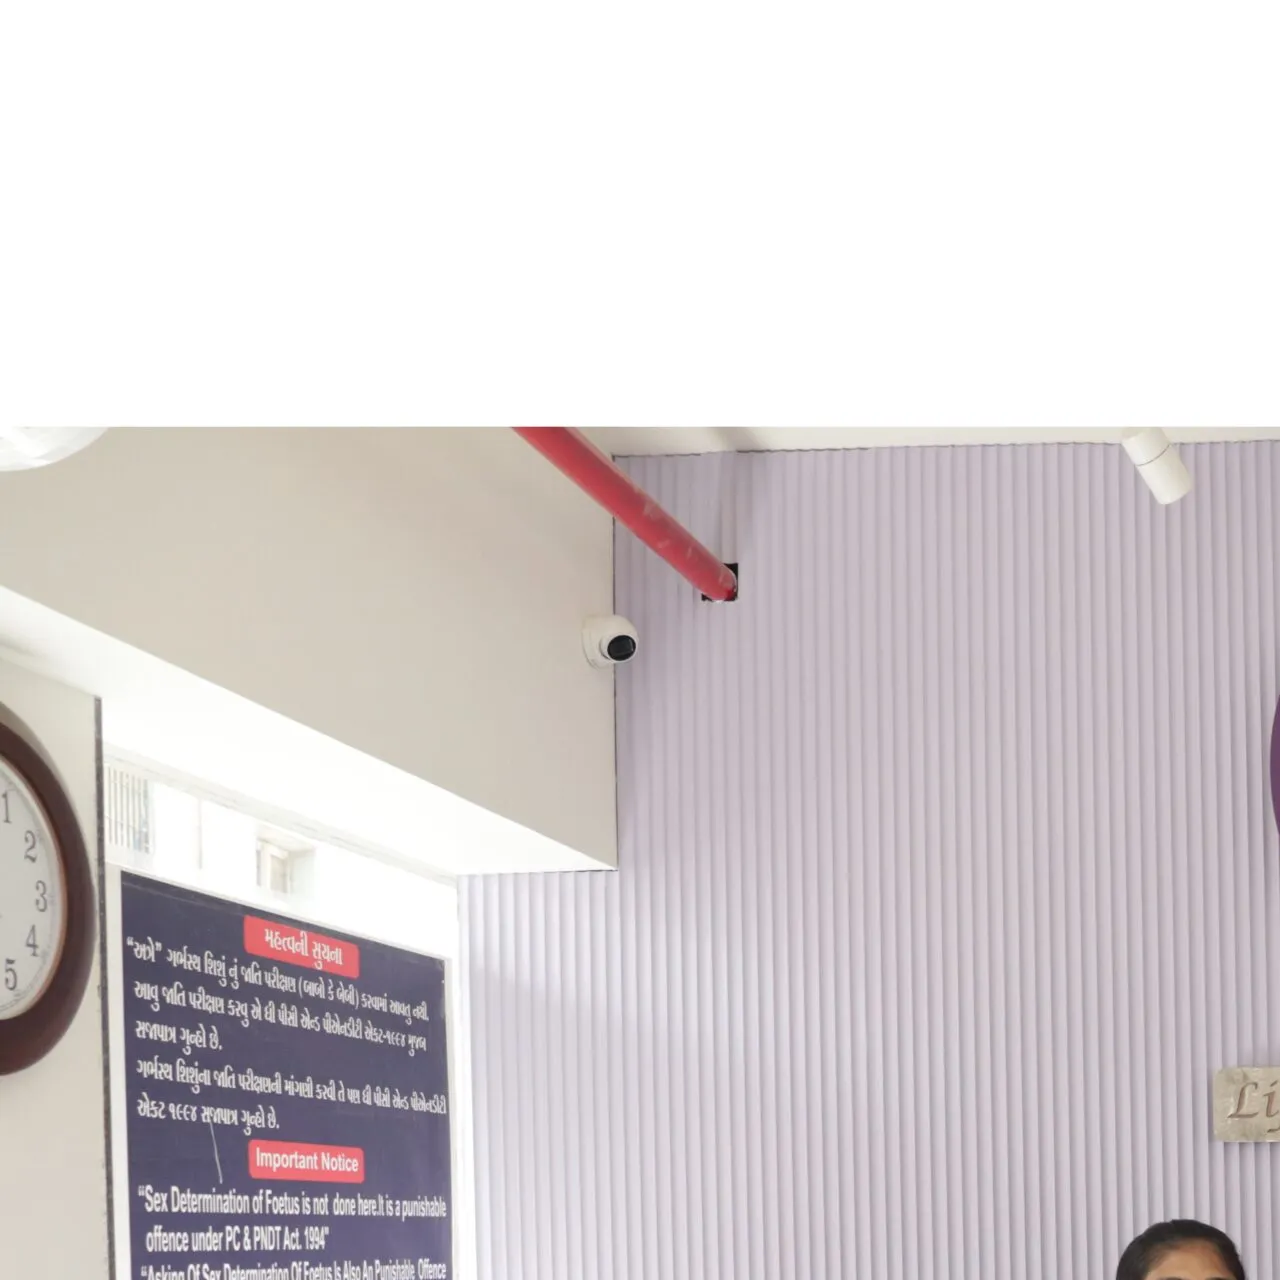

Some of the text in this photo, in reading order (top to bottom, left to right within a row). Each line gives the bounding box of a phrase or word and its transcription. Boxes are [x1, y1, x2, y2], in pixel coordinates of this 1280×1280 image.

[2, 790, 12, 824] 1
[24, 829, 37, 863] 2
[35, 880, 47, 912] 3
[25, 924, 39, 957] 4
[5, 958, 18, 991] 5
[166, 945, 201, 972] ગર્ભસ્થ
[241, 961, 262, 985] જાતિ
[264, 966, 297, 993] પરીક્ષણ
[327, 979, 335, 1001] કે
[361, 992, 388, 1013] કરવામાં
[162, 981, 187, 1007] જાતિ
[188, 986, 225, 1014] પરીક્ષણ
[251, 996, 262, 1021] એ
[278, 1003, 298, 1028] પીસી
[407, 1034, 427, 1057] મુજબ
[136, 1055, 173, 1081] ગર્ભસ્થ
[213, 1065, 236, 1089] જાતિ
[238, 1068, 282, 1095] પરીક્ષણની
[284, 1074, 314, 1098] માંગણી
[316, 1079, 337, 1101] કરવી
[338, 1080, 346, 1102] તે
[347, 1087, 361, 1104] પણ
[373, 1085, 391, 1108] પીસી
[256, 1146, 359, 1172] Important Notice
[170, 1185, 250, 1214] Determination
[252, 1188, 263, 1214] of
[265, 1189, 300, 1215] Foetus
[301, 1191, 311, 1215] is
[313, 1193, 329, 1215] not
[332, 1192, 356, 1216] done
[385, 1194, 393, 1216] is
[395, 1199, 401, 1217] a
[401, 1195, 447, 1222] punishable
[145, 1225, 189, 1252] offence
[191, 1226, 223, 1252] under
[225, 1225, 241, 1251] PC
[243, 1225, 252, 1251] &
[253, 1226, 282, 1251] PNDT
[283, 1226, 302, 1250] Act.
[417, 1258, 447, 1280] Offence
